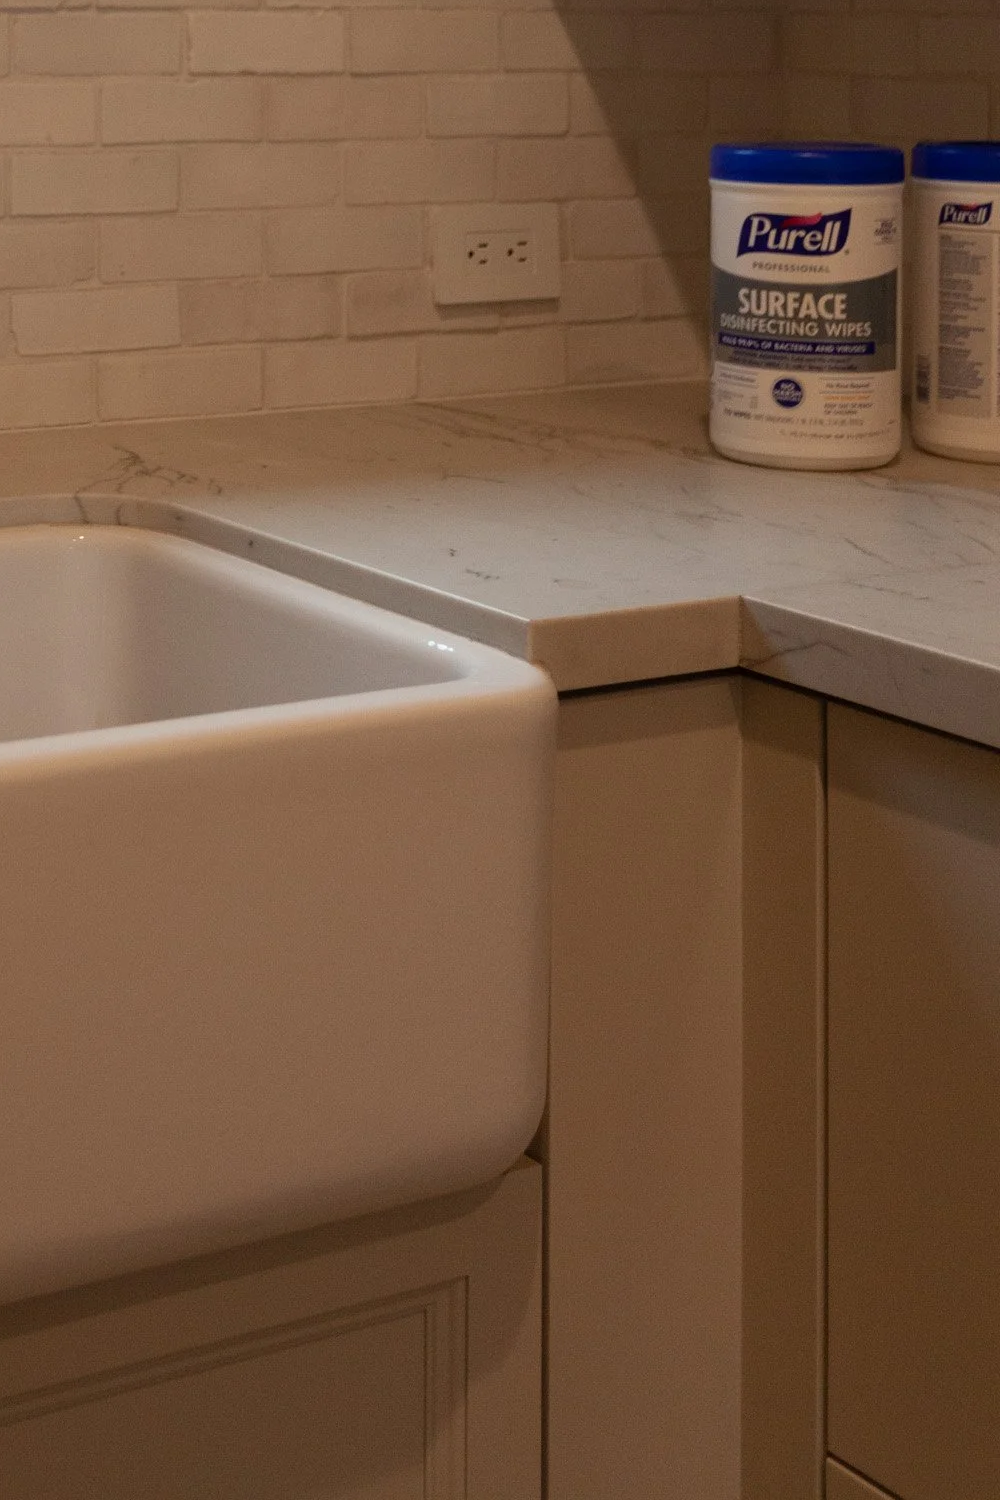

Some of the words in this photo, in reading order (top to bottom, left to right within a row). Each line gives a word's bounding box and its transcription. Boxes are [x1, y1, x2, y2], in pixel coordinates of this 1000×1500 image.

[944, 205, 988, 224] Purell
[747, 216, 842, 252] Purell
[752, 261, 830, 273] PROFESSIONAL
[738, 287, 848, 320] SURFACE
[720, 313, 819, 337] DISINFECTING
[824, 321, 872, 337] WIPES
